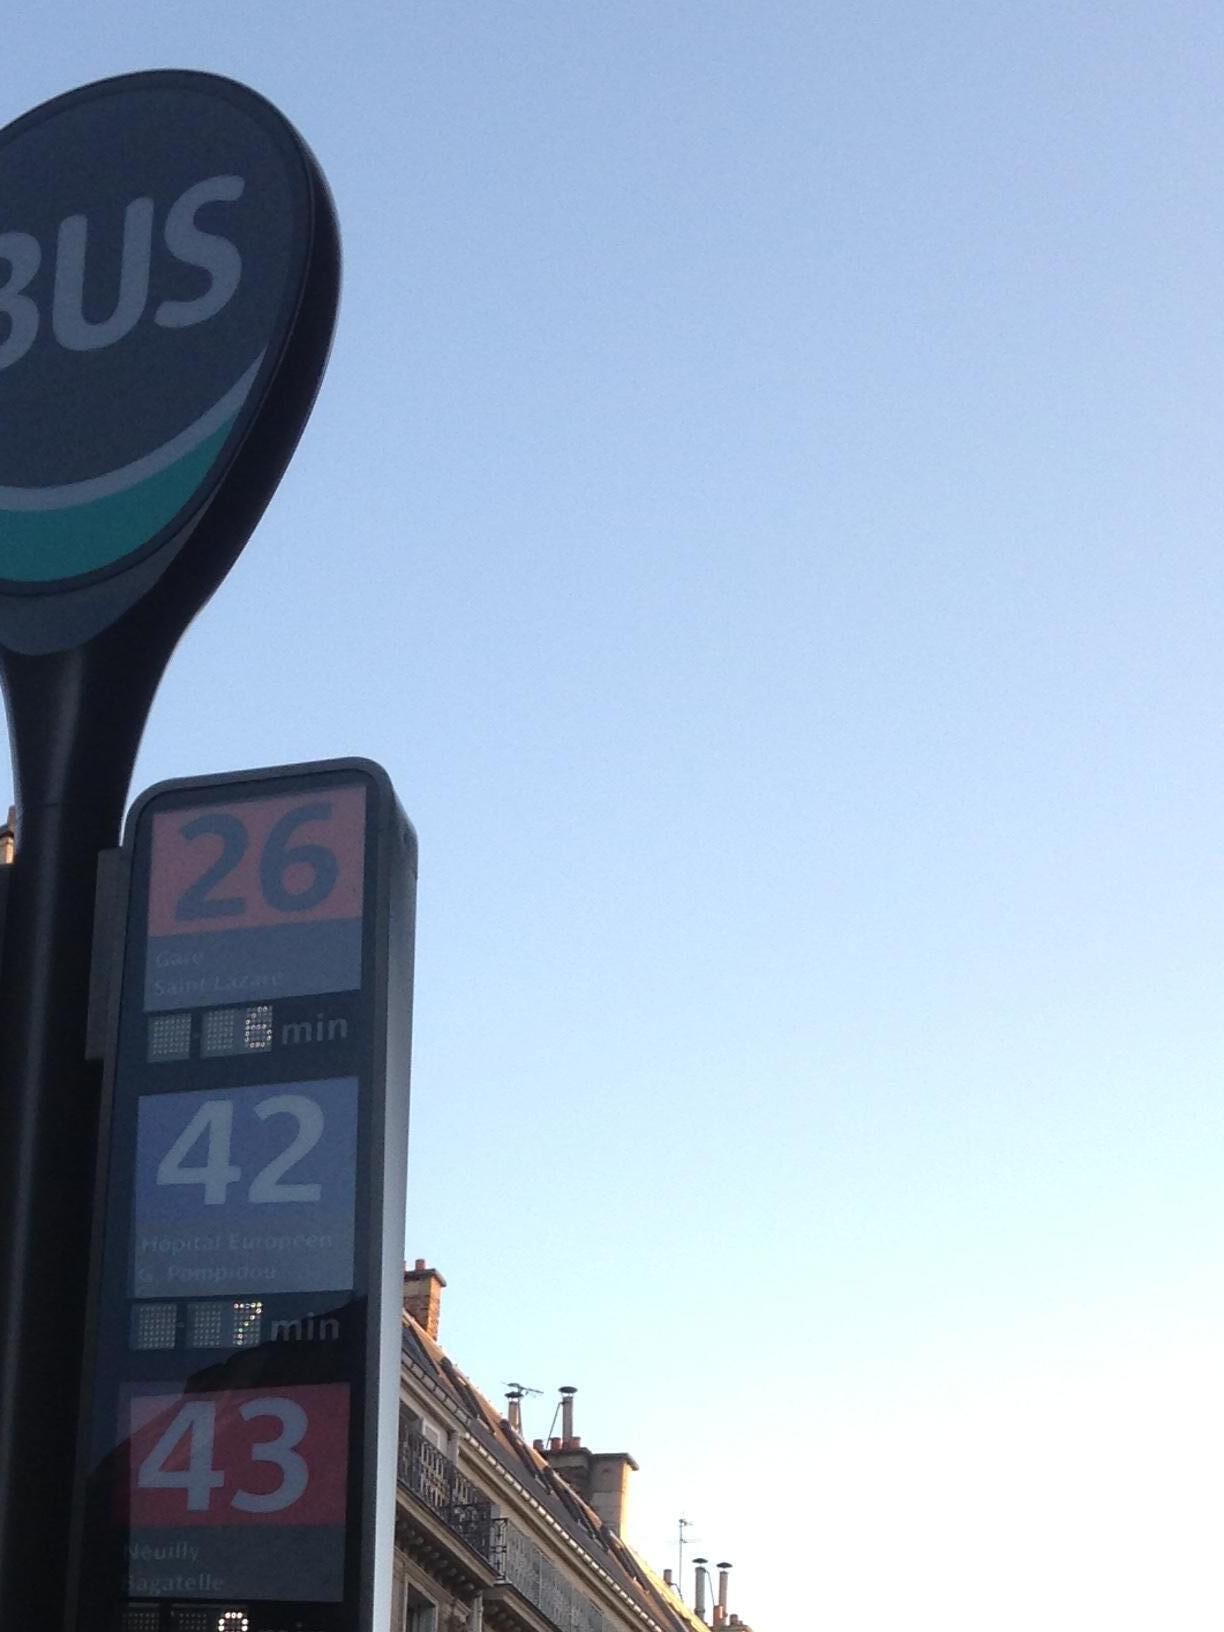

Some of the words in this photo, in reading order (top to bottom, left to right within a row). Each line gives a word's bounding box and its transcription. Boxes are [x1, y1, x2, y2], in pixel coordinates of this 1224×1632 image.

[175, 801, 339, 920] 26
[281, 1013, 348, 1046] min
[156, 1095, 325, 1205] 42
[232, 1301, 263, 1346] 7
[271, 1312, 341, 1342] min
[138, 1396, 310, 1513] 43
